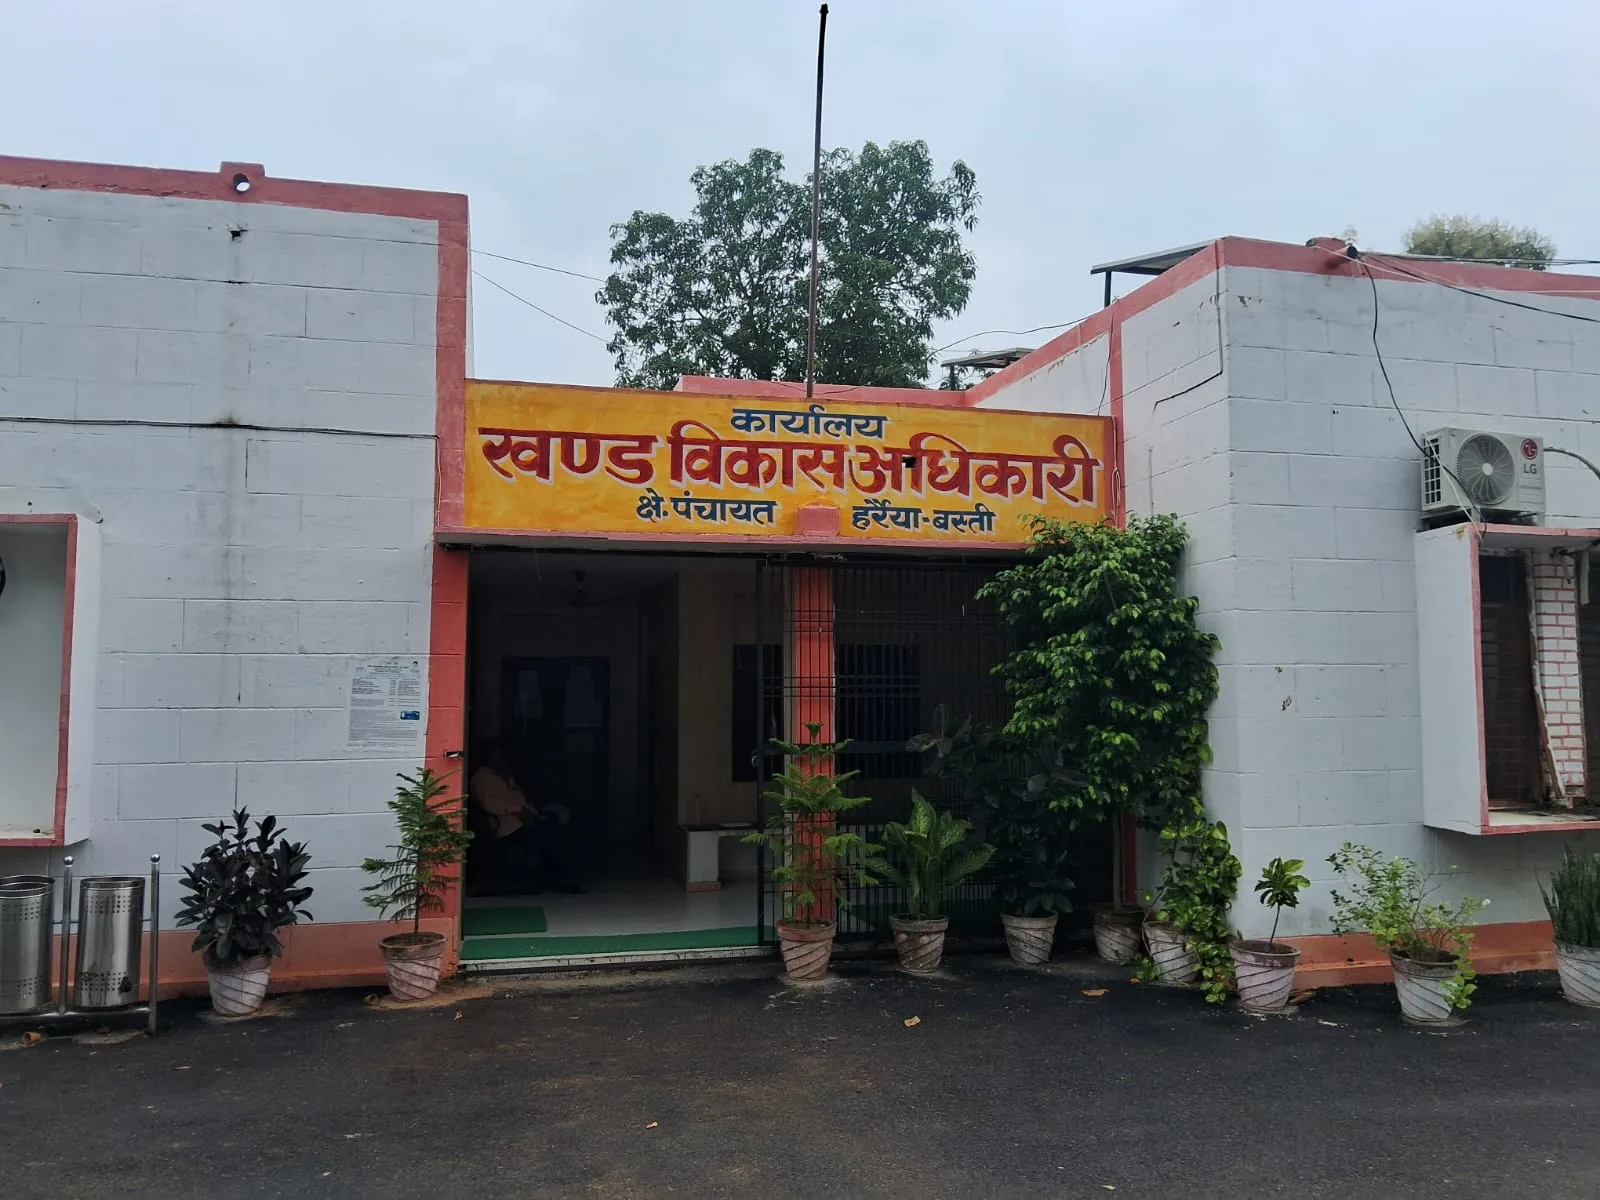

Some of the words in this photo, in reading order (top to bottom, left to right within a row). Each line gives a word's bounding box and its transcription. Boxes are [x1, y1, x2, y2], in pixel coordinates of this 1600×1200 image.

[730, 403, 889, 440] कार्यालय
[477, 426, 659, 486] खण्ड
[666, 419, 849, 490] विकास
[848, 431, 1101, 504] अधिकारी
[1523, 463, 1538, 475] LG
